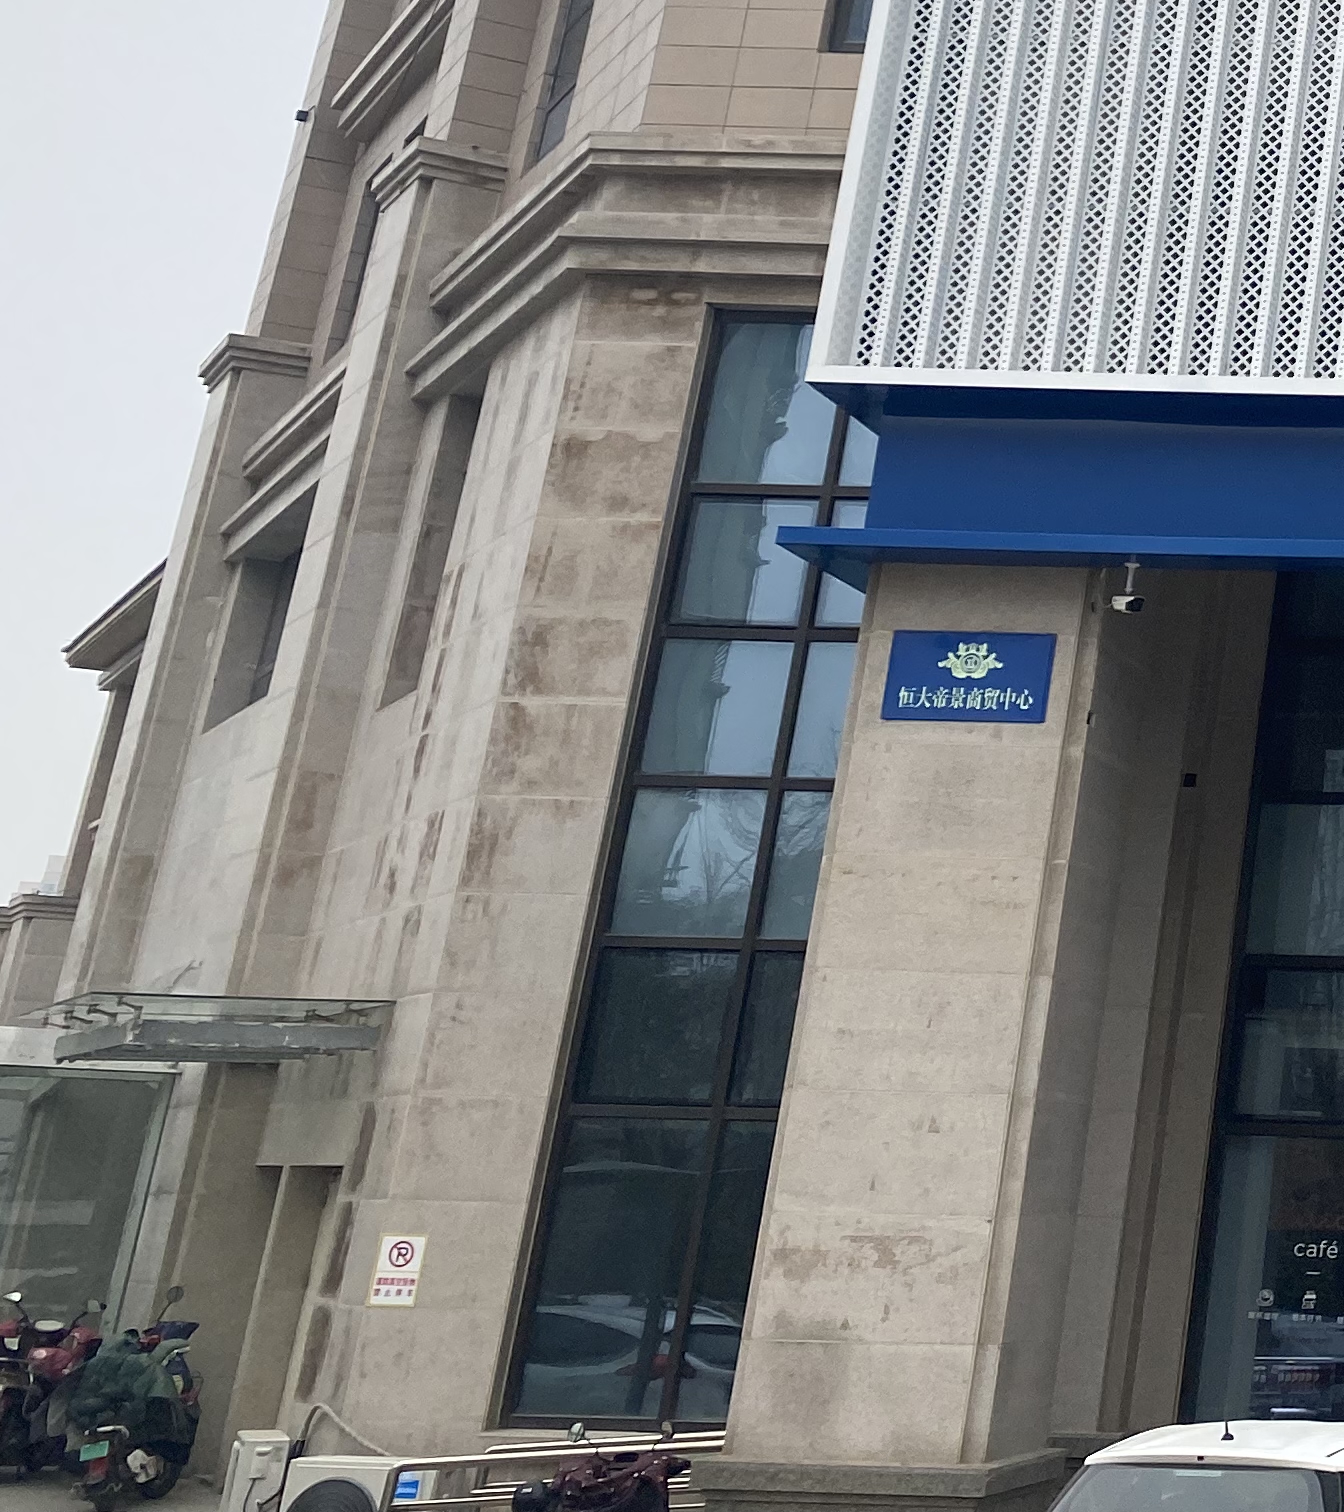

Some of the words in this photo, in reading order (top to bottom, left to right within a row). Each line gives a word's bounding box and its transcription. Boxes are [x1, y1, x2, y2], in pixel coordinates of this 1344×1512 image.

[898, 685, 1034, 711] 恒大帝景商贸中心
[1293, 1240, 1339, 1259] café
